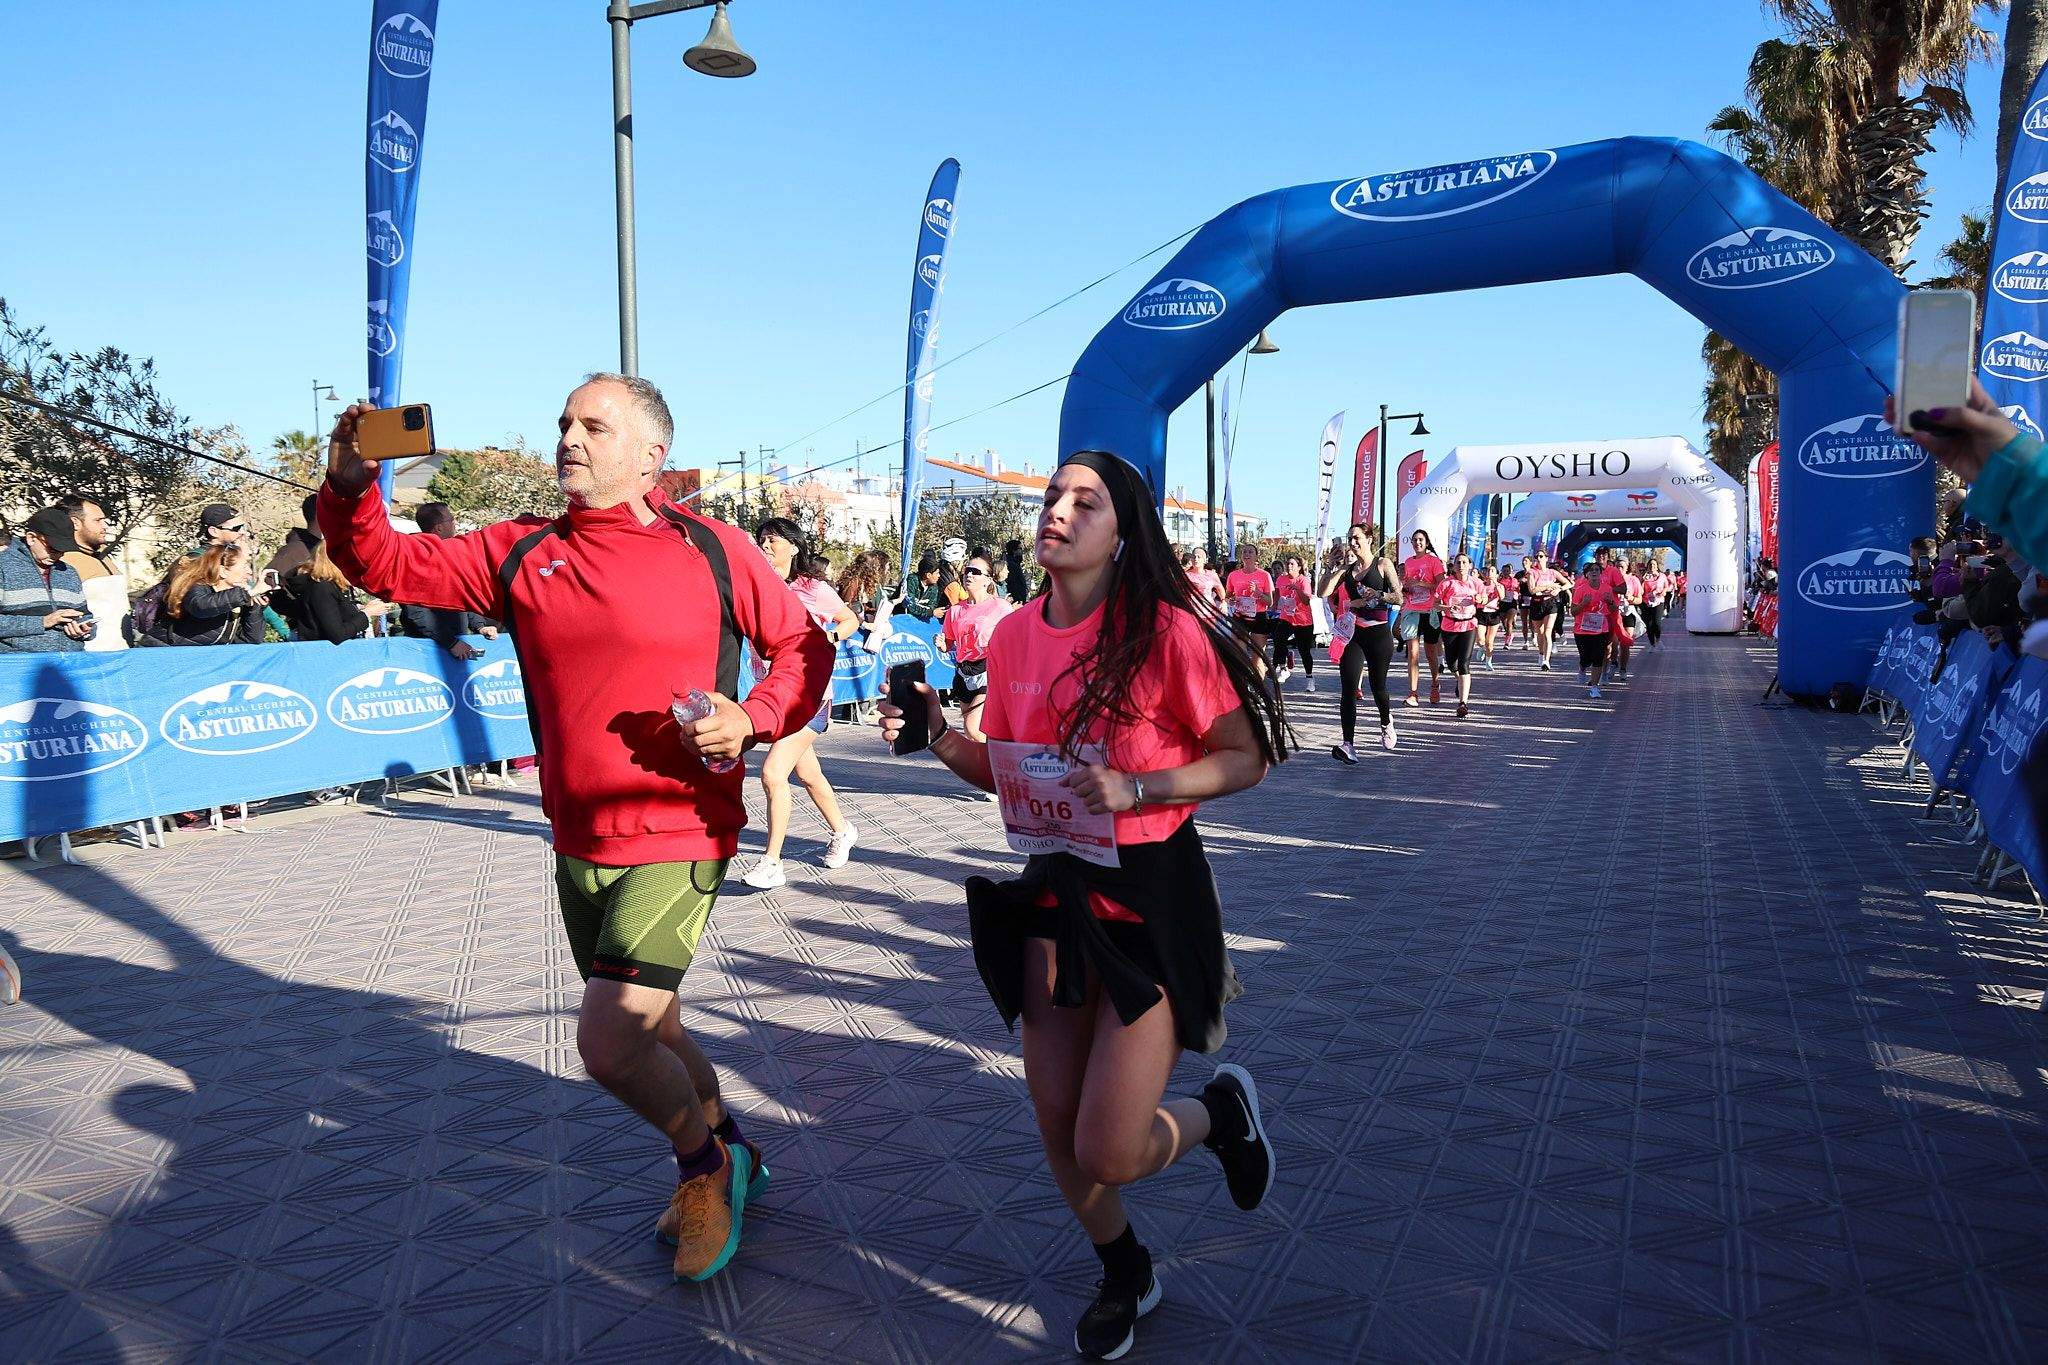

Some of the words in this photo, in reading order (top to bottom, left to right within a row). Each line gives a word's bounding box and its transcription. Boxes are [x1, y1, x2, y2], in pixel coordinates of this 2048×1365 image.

[379, 32, 431, 67] ASTURIANA
[1345, 158, 1538, 207] ASTURIANA
[2011, 189, 2048, 210] ASTU
[1718, 246, 1767, 259] CENTRAL
[1770, 242, 1819, 252] LECHERA
[1698, 249, 1826, 280] ASTURIANA
[1997, 268, 2048, 290] ASTURIA
[1145, 295, 1176, 304] CENTRAL
[1128, 302, 1218, 320] ASTURIANA
[1826, 436, 1876, 446] CENTRAL
[1806, 441, 1924, 466] ASTURIANA
[1495, 450, 1631, 481] OYSHO
[1358, 449, 1372, 516] Santander
[1671, 475, 1715, 486] OYSHO
[1768, 460, 1779, 520] Santander
[1420, 486, 1458, 495] OYSHO
[1595, 526, 1664, 535] VOLVO
[1825, 569, 1875, 578] CENTRAL
[1878, 568, 1914, 576] LECHE
[1693, 584, 1735, 594] OYSHO
[355, 690, 401, 700] CENTRAL
[401, 685, 443, 696] LECHERA
[472, 683, 526, 708] ASTUR
[197, 704, 248, 717] CENTRAL
[250, 700, 300, 711] LECHERA
[340, 694, 451, 723] ASTURIANA
[3, 725, 58, 738] ENTRAL
[62, 719, 126, 732] LECHERA
[176, 708, 311, 743] ASTURIANA
[0, 729, 138, 764] STURIANA
[1021, 760, 1066, 773] ASTURIANA
[1019, 838, 1054, 849] OYSHO
